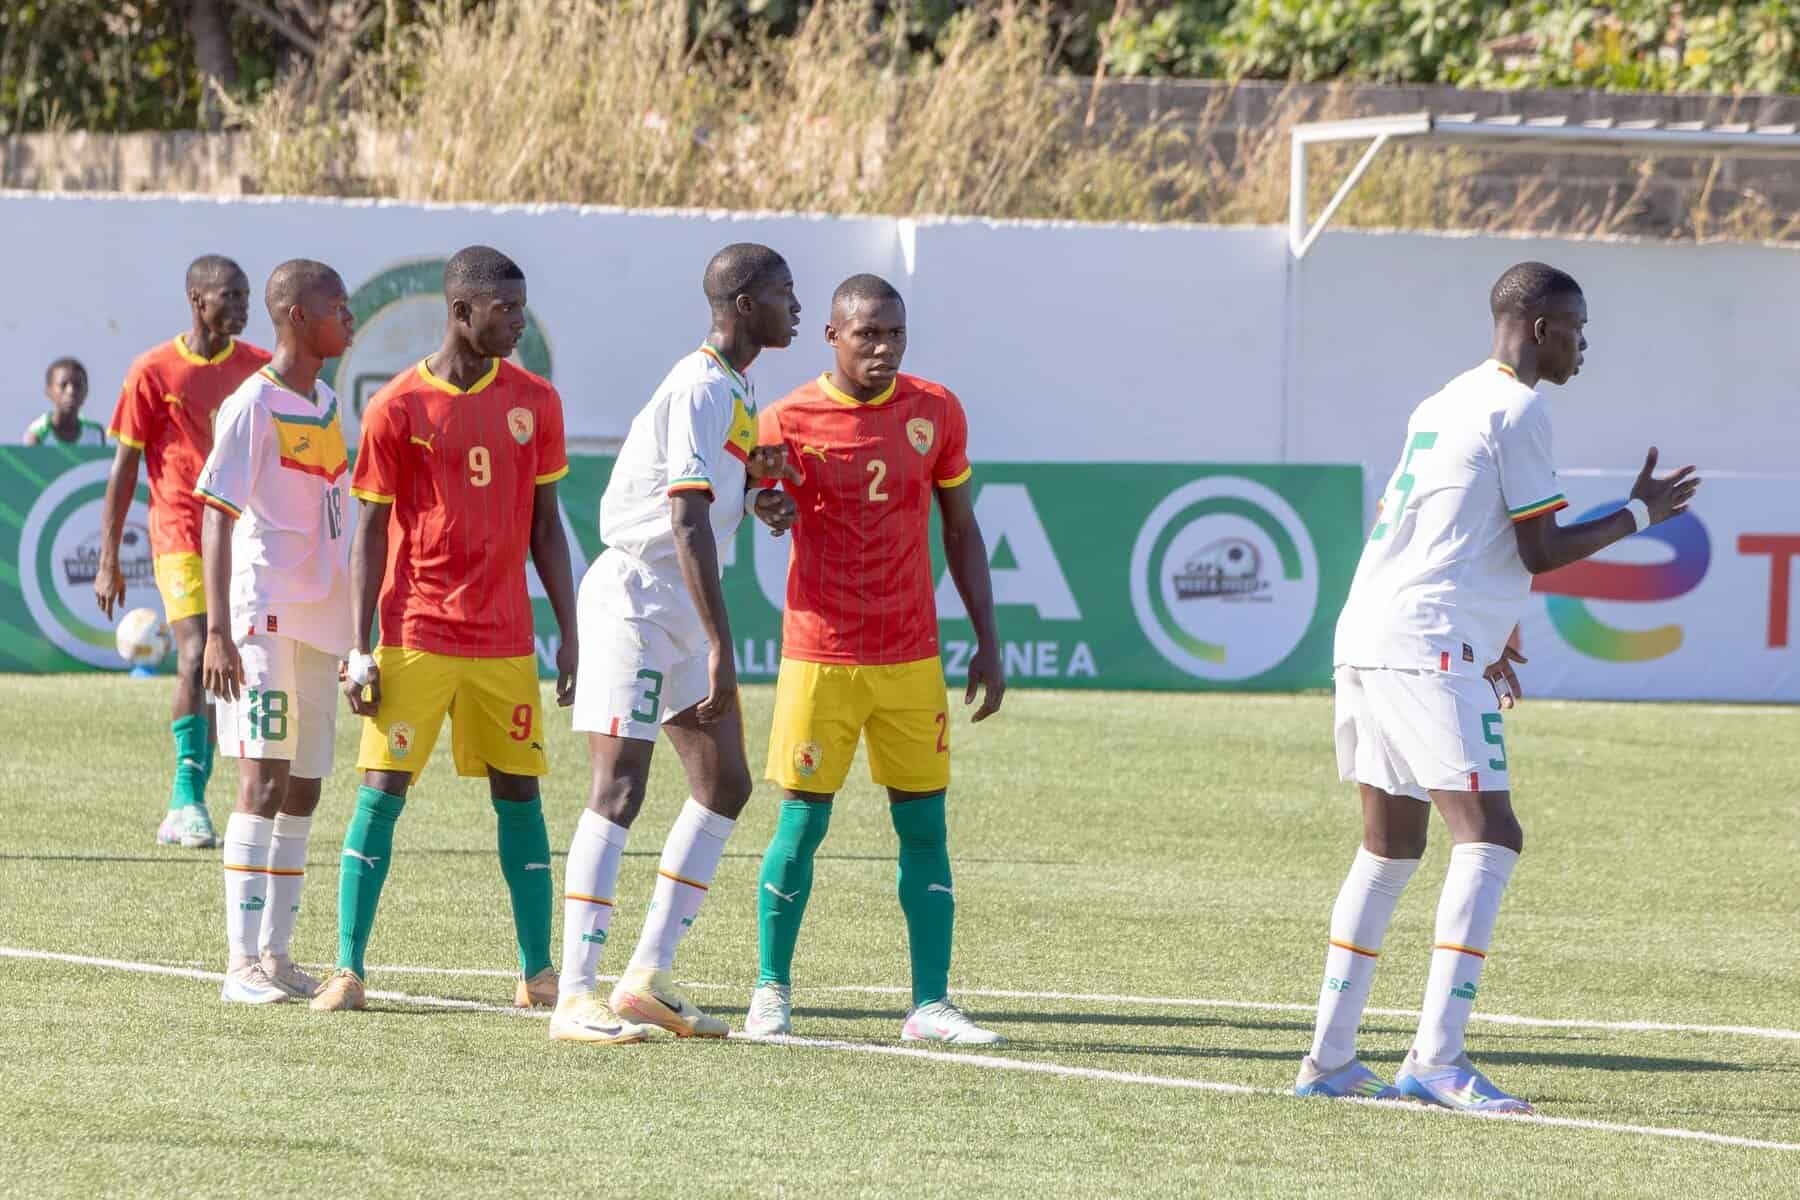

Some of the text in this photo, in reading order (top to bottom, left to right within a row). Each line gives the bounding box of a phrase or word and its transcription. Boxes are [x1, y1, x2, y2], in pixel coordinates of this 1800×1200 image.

[468, 446, 491, 487] 9
[866, 459, 889, 502] 2
[945, 639, 1098, 677] ZNE A
[248, 689, 288, 740] 18
[631, 668, 663, 724] 3
[510, 704, 532, 742] 9
[935, 711, 949, 753] 2
[1481, 713, 1507, 771] 5
